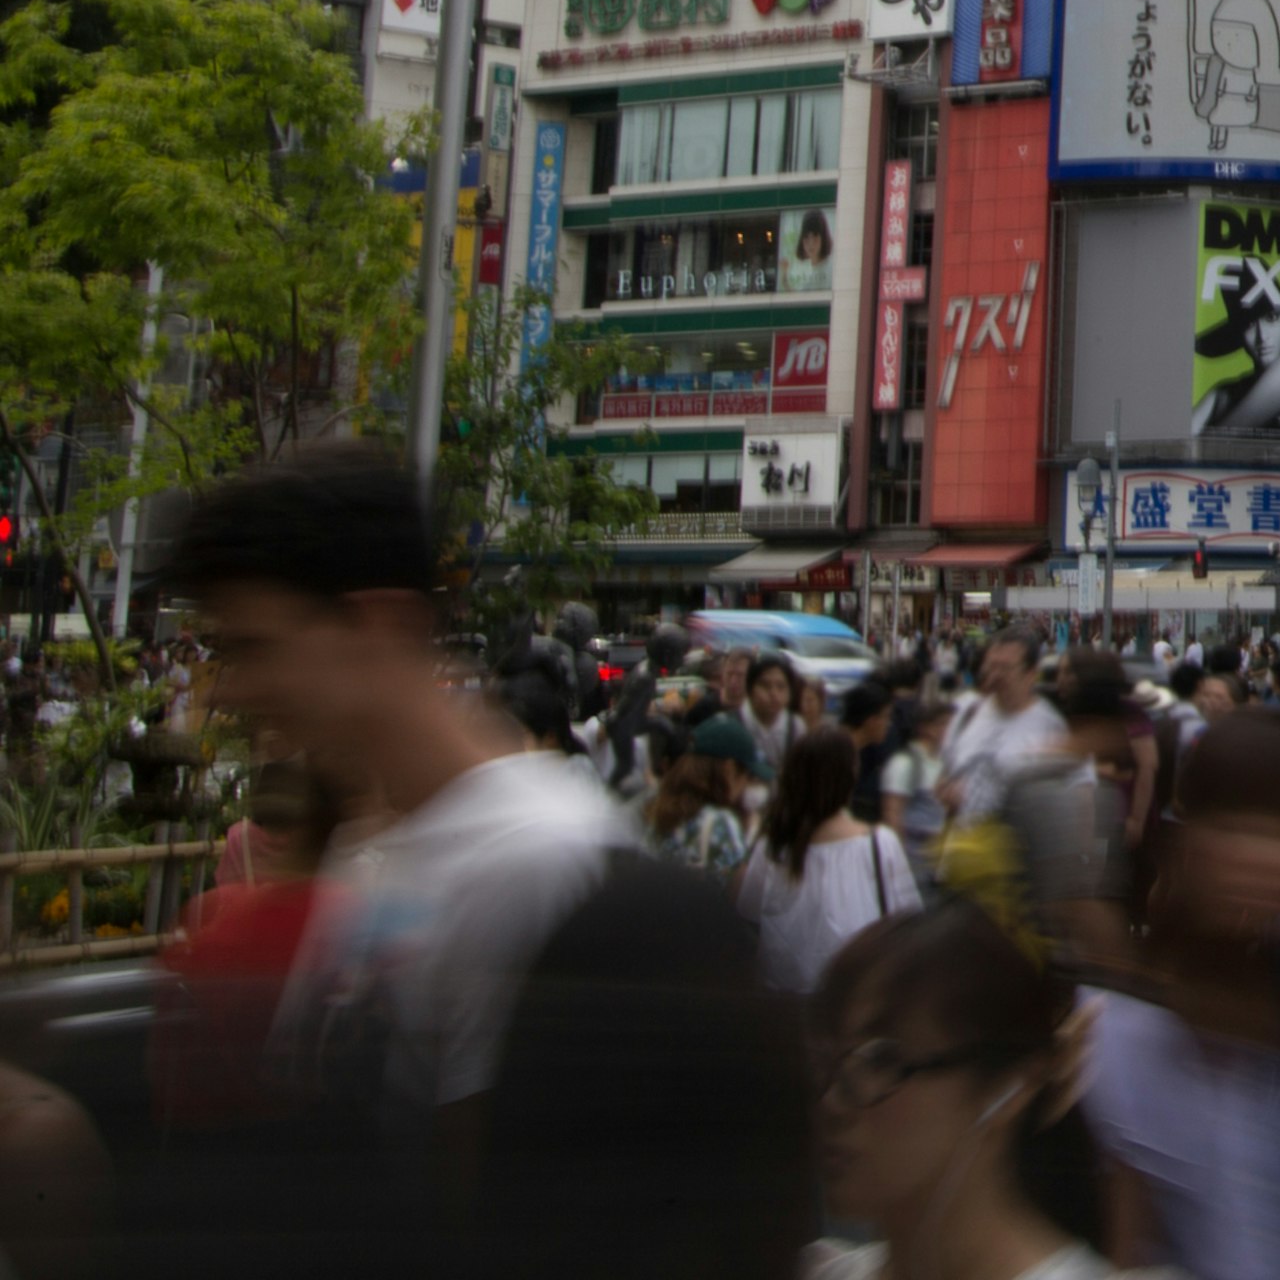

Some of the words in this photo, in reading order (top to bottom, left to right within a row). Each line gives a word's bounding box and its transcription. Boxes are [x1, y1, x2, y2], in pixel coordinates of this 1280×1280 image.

[1214, 162, 1245, 177] DHC
[618, 263, 767, 300] Euphoria
[936, 261, 1041, 408] クスリ
[777, 337, 828, 380] JTB
